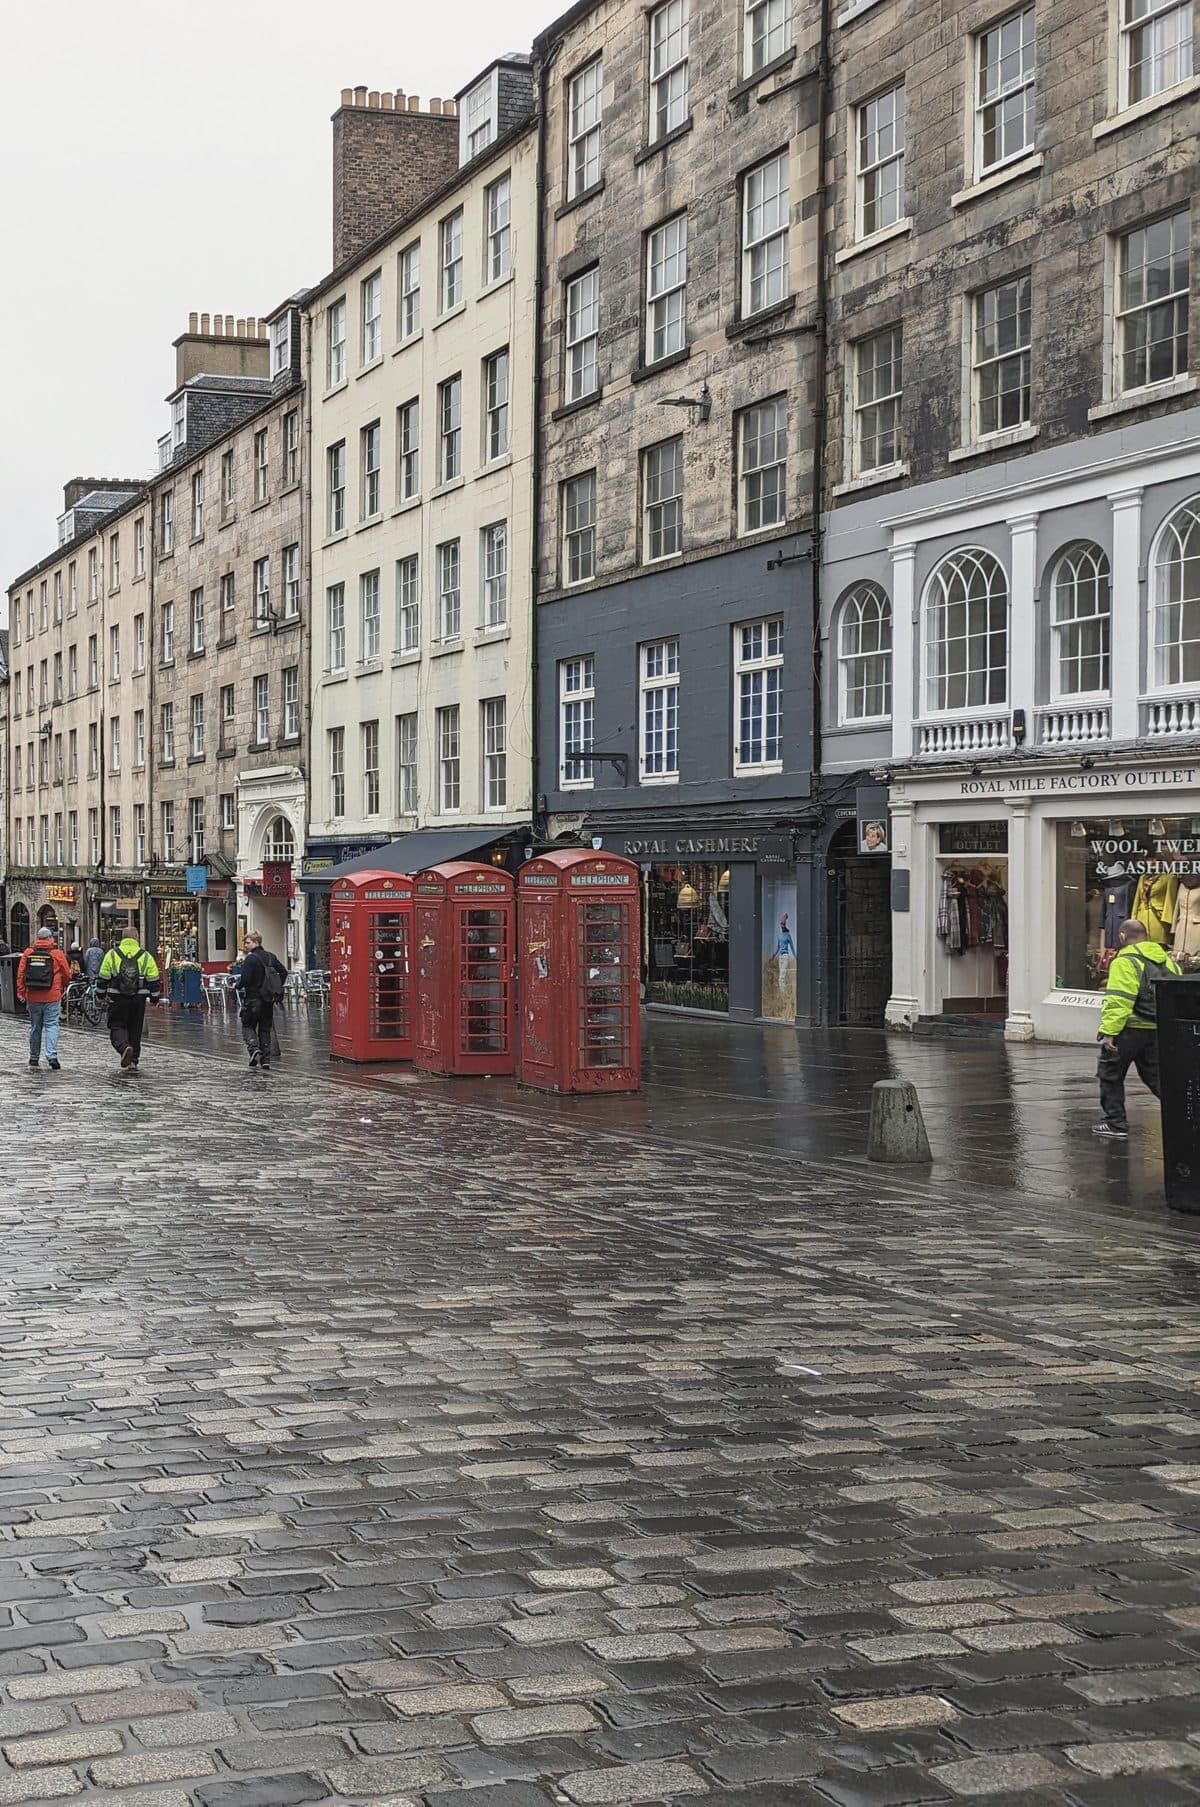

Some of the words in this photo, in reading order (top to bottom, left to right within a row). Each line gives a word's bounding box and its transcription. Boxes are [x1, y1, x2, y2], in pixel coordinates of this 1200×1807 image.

[960, 780, 1005, 794] ROYAL
[1008, 778, 1046, 791] MILE
[1050, 773, 1120, 790] FACTORY
[1125, 769, 1196, 785] OUTLET
[623, 840, 669, 854] ROYAL
[675, 837, 761, 854] CASHMERE
[1090, 839, 1148, 856] WOOL,
[1153, 839, 1200, 853] TWE
[1095, 861, 1108, 875] &
[573, 875, 629, 885] TELEPHONE
[1061, 995, 1096, 1005] ROYAL
